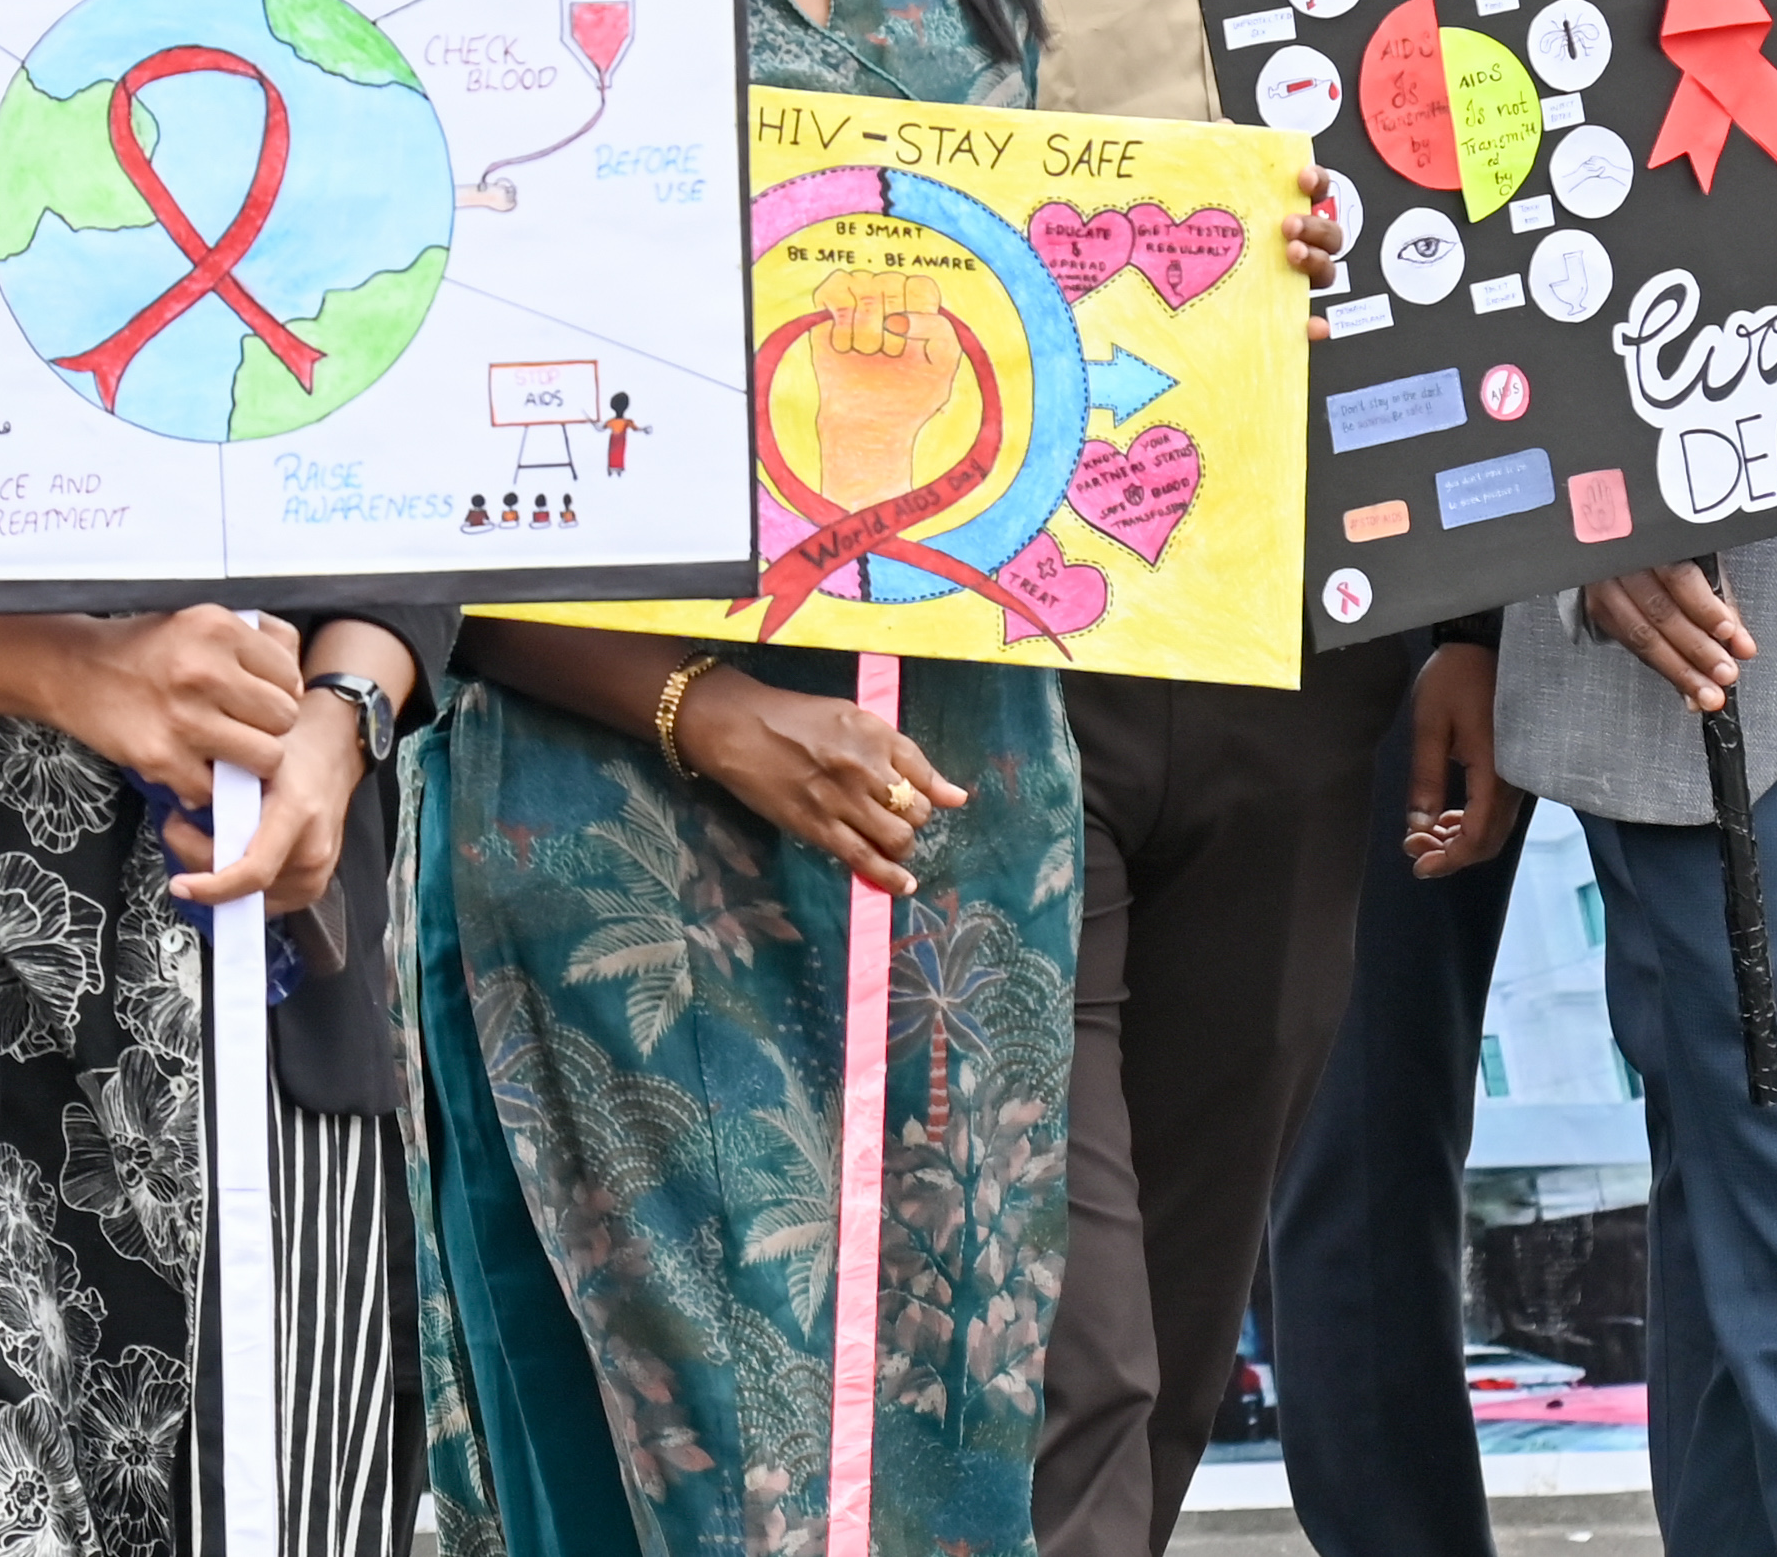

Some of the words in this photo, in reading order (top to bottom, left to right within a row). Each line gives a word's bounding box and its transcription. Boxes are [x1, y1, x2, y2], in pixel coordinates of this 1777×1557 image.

[424, 35, 526, 67] CHECK
[1381, 32, 1434, 60] AIDS
[466, 65, 558, 94] BLOOD
[1459, 63, 1503, 89] AIDS
[1497, 91, 1530, 117] not
[595, 143, 704, 180] BEFORE
[1042, 133, 1144, 179] SAFE
[654, 179, 706, 204] USE
[836, 221, 858, 236] BE
[865, 223, 924, 240] SMART
[787, 245, 811, 262] BE
[815, 248, 856, 266] SAFE
[885, 253, 906, 269] BE
[911, 255, 977, 272] AWARE
[514, 367, 561, 388] STOP
[524, 389, 564, 408] AIDS
[49, 474, 102, 495] AND
[282, 495, 454, 525] AWARENESS
[798, 511, 889, 570] World
[1009, 572, 1061, 609] TREAT
